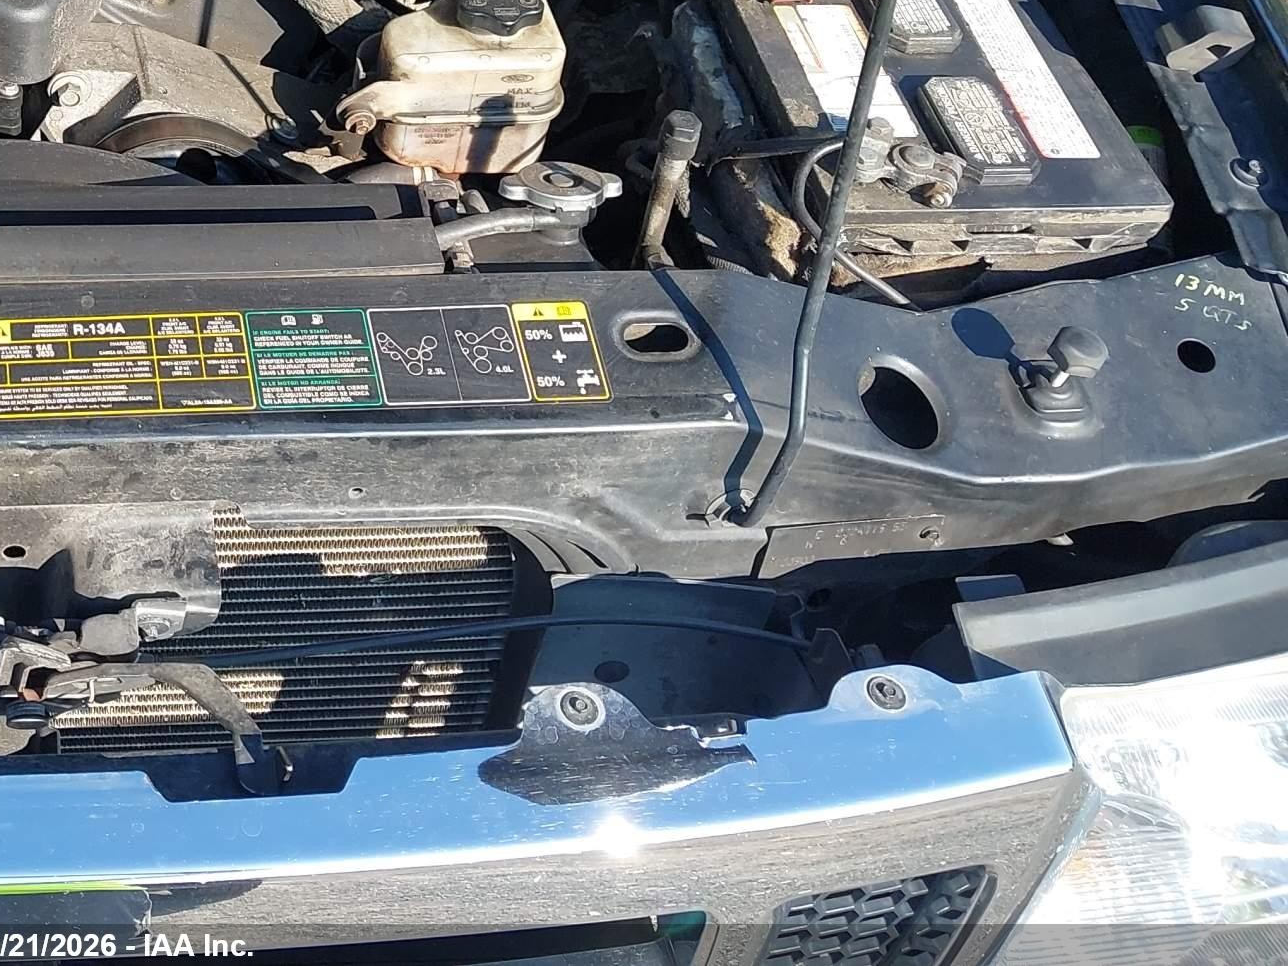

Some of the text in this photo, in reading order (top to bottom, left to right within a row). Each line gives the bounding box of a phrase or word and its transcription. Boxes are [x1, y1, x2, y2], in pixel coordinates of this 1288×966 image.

[1174, 297, 1197, 312] 5
[72, 322, 125, 336] R-134A
[525, 329, 553, 341] 50%
[495, 365, 514, 373] 4.0L
[537, 376, 566, 387] 50%
